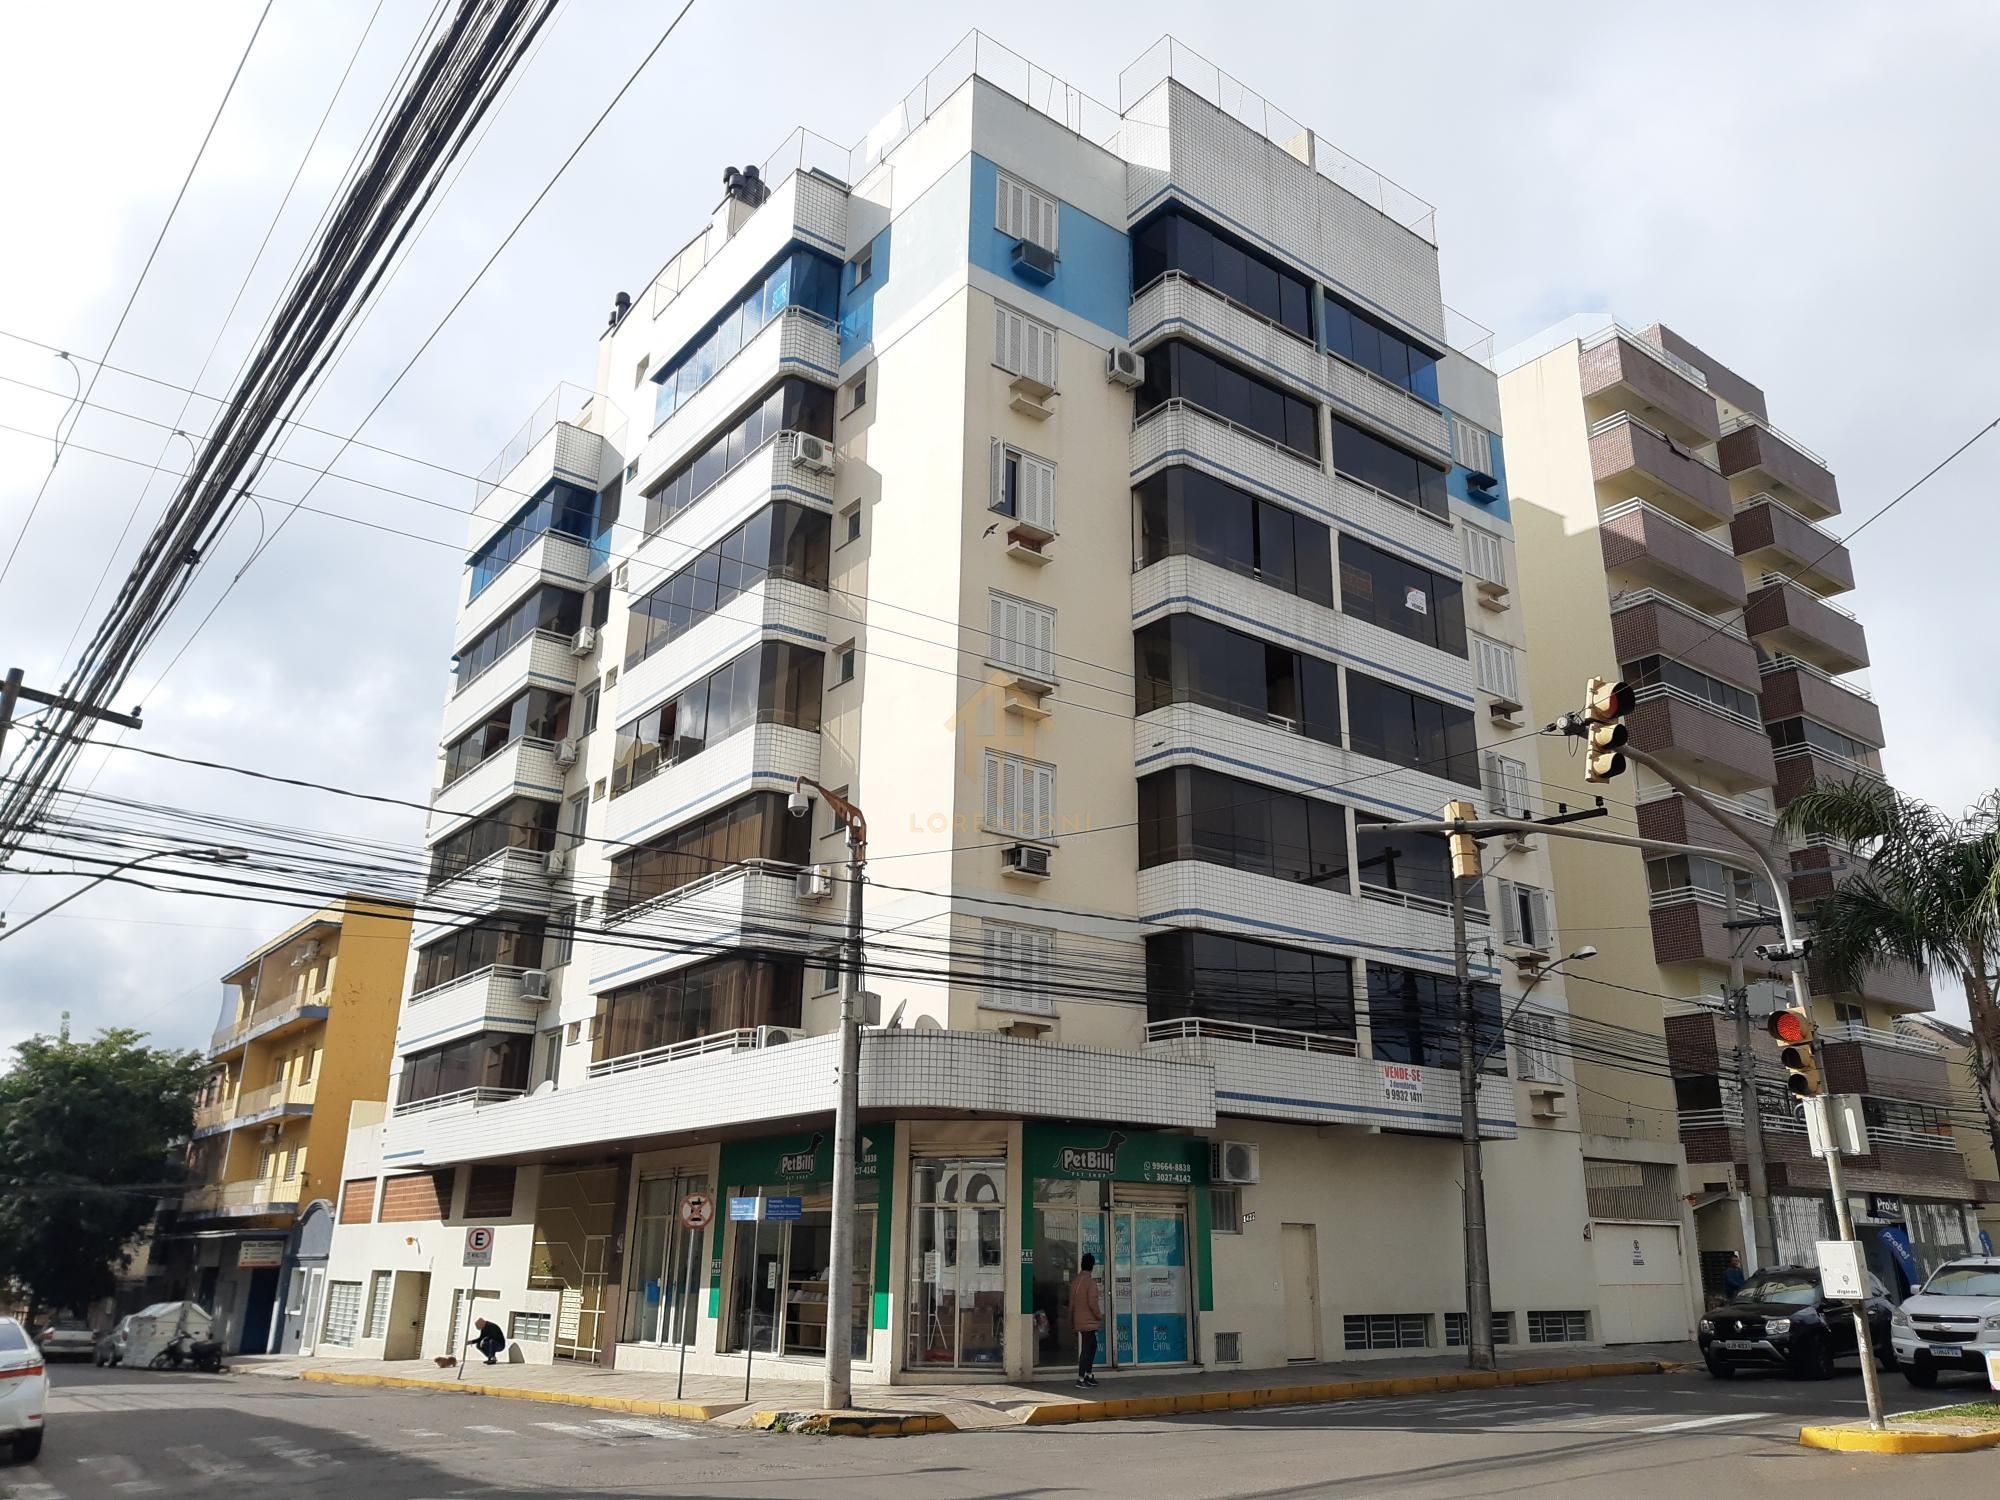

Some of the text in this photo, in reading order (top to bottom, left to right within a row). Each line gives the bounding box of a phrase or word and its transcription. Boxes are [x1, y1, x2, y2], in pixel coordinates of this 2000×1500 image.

[1384, 1065, 1421, 1081] VENDE-SE
[1386, 1089, 1422, 1103] 9 9932 1411
[1156, 1173, 1192, 1183] 3027-4142
[1876, 1198, 1900, 1212] Probel
[475, 1232, 485, 1246] E
[1883, 1231, 1911, 1260] Probel
